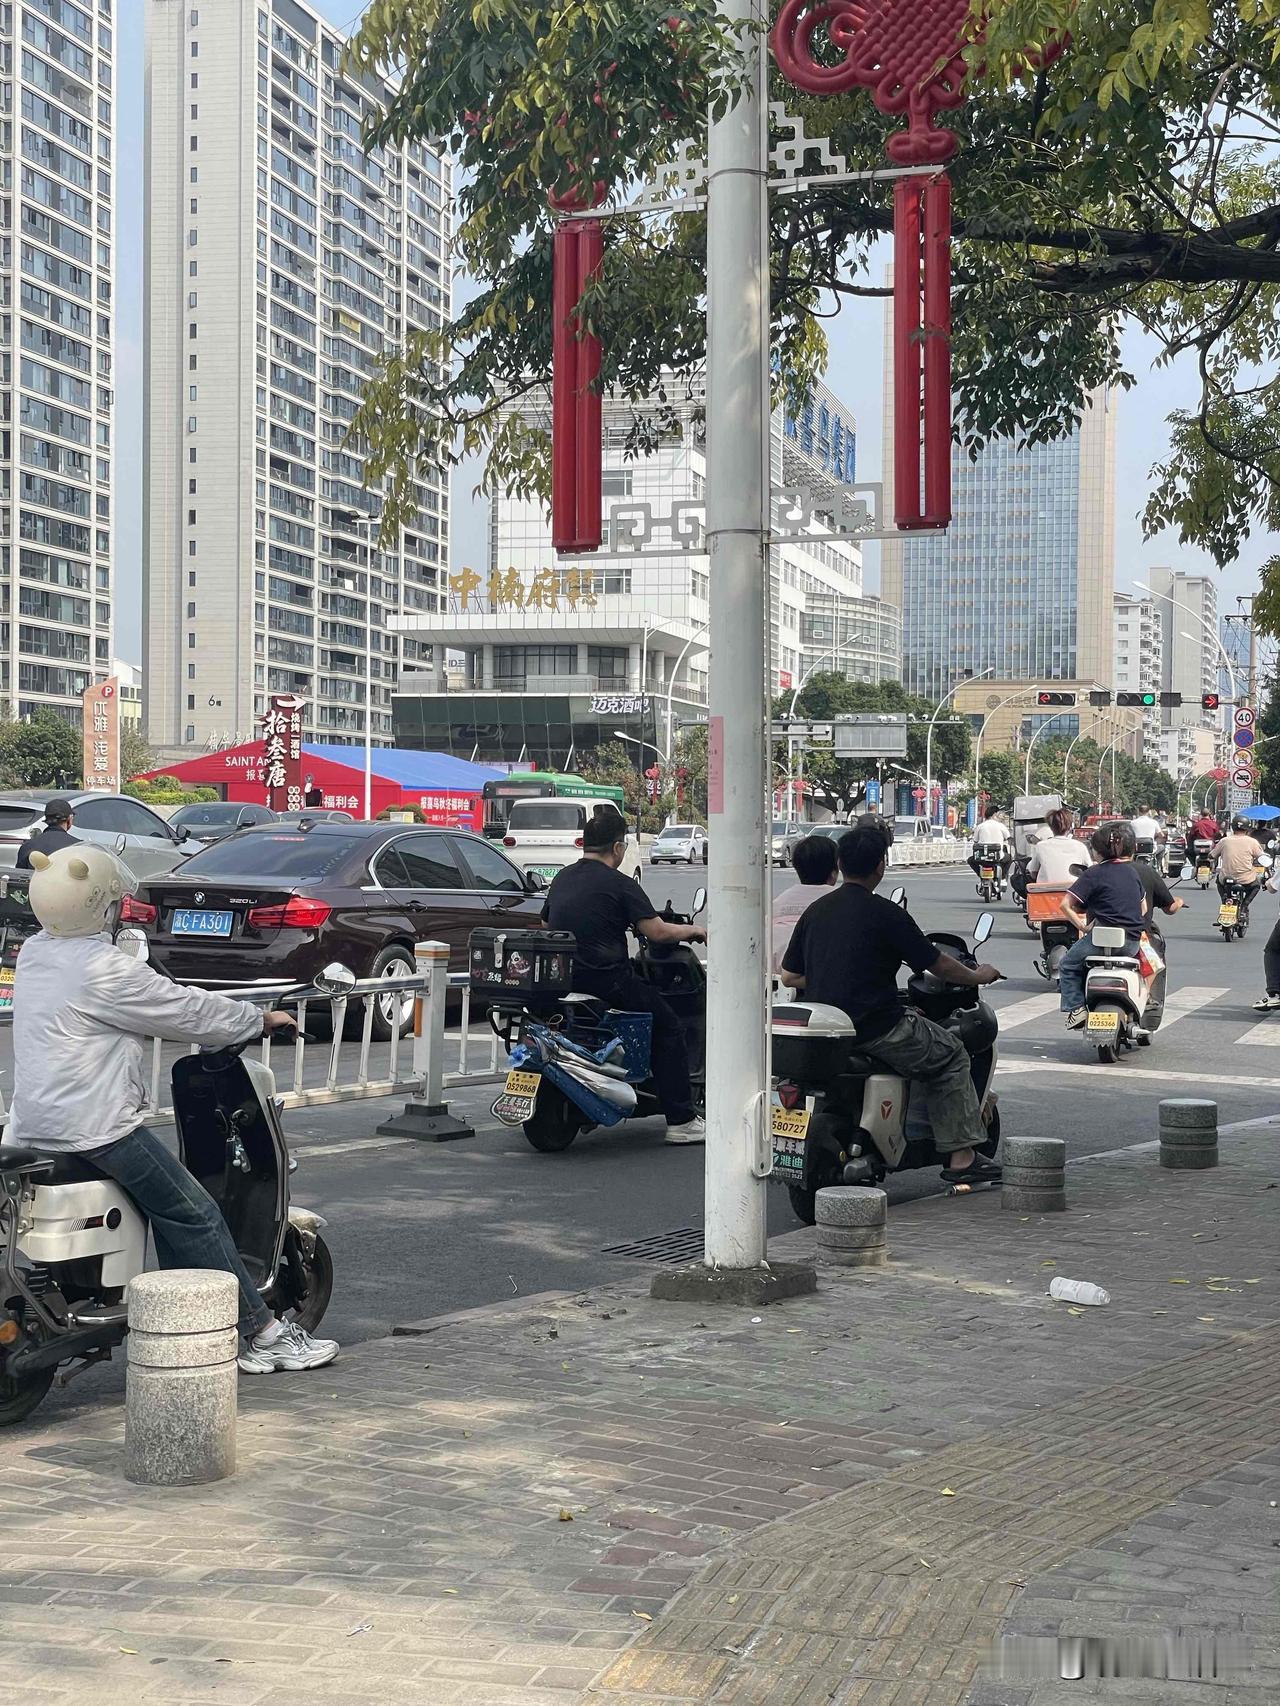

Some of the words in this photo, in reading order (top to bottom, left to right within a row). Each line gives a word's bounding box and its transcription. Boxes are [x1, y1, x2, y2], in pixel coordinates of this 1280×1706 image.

[104, 687, 112, 697] P
[588, 695, 650, 715] 迈克酒吧
[1237, 713, 1251, 723] 40
[225, 756, 255, 767] SAINT
[86, 776, 116, 786] 停车场
[323, 795, 359, 809] 福利会
